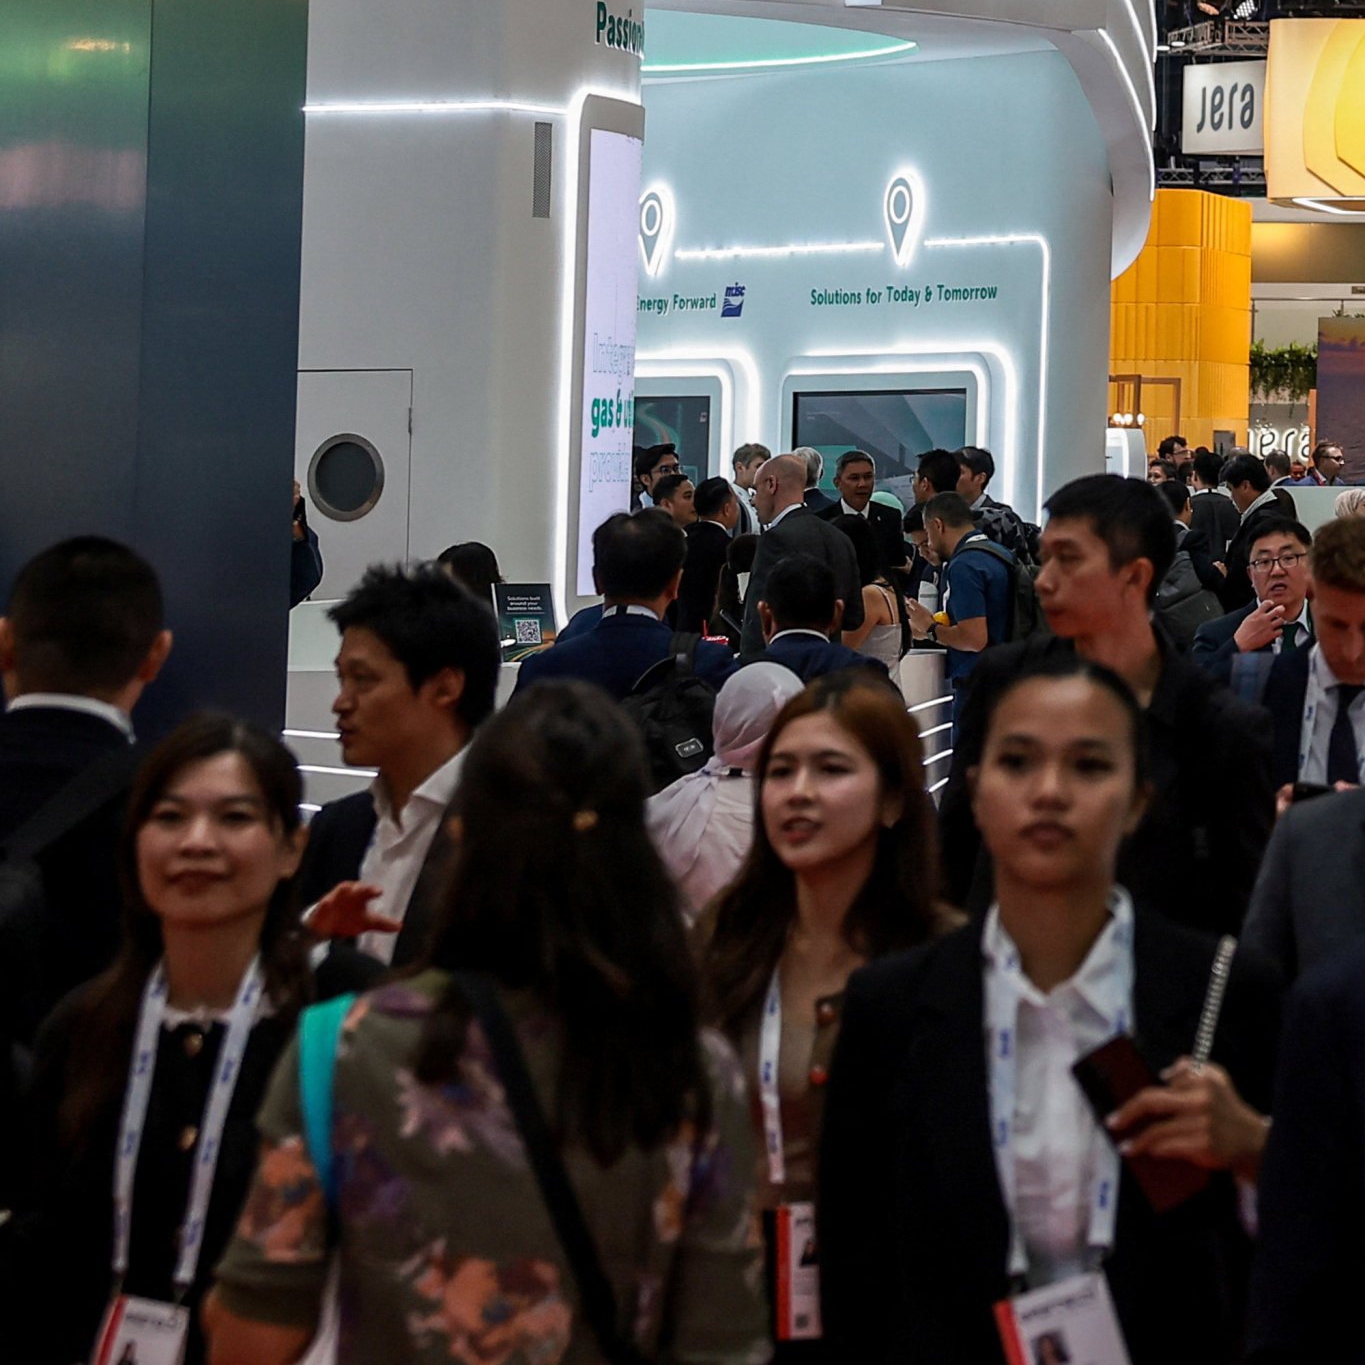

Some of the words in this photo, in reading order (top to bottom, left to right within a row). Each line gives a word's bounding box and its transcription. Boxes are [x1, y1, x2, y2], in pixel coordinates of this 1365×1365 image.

[672, 293, 717, 310] Forward
[810, 288, 862, 306] Solutions
[865, 287, 882, 303] for
[886, 286, 921, 308] Today
[924, 286, 933, 302] &
[937, 284, 998, 302] Tomorrow
[591, 398, 614, 438] gas
